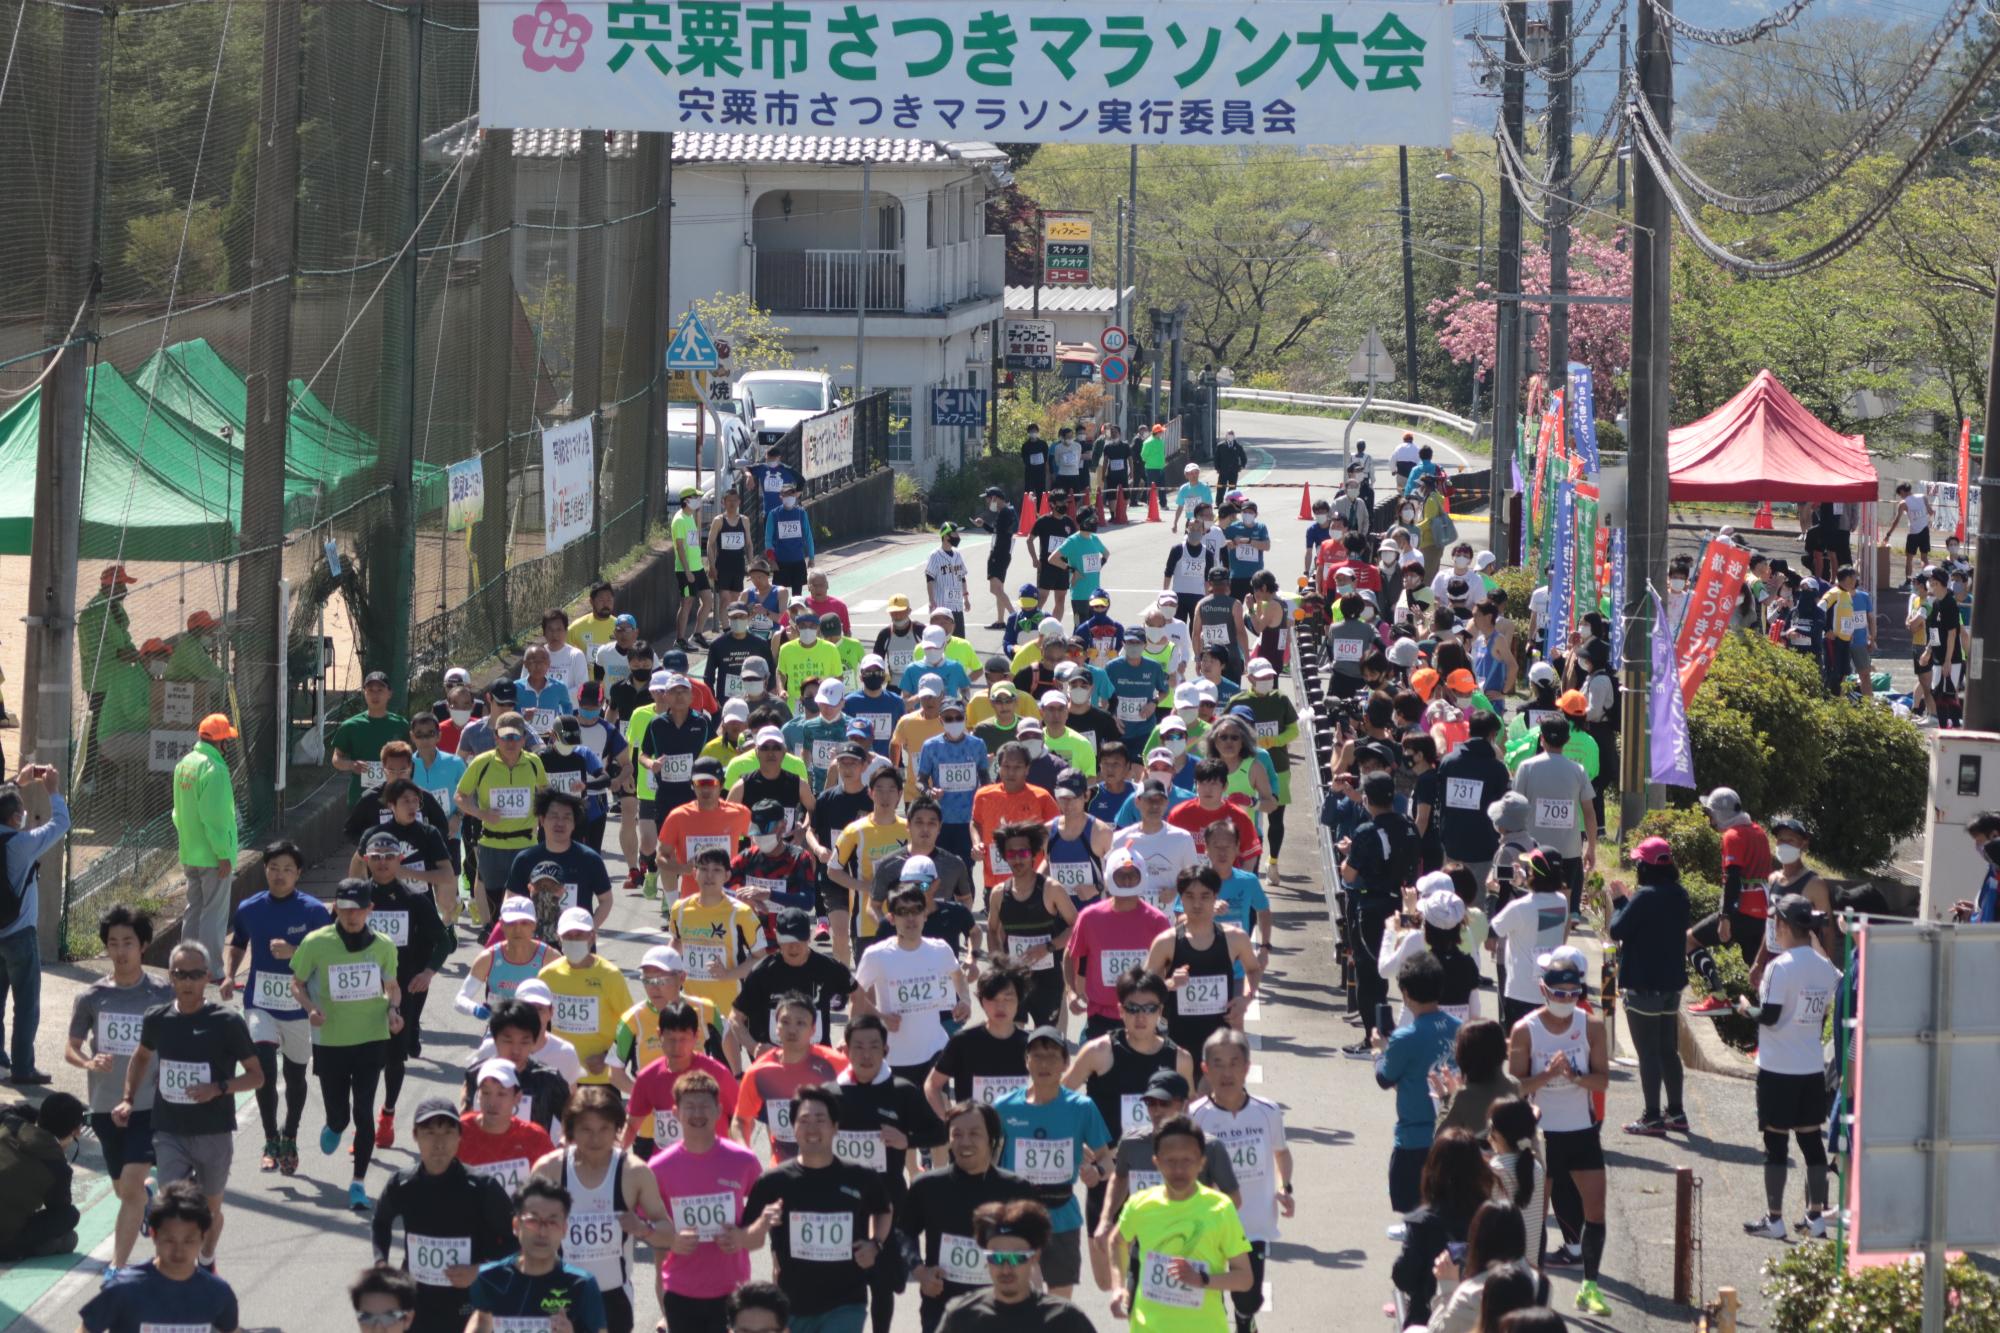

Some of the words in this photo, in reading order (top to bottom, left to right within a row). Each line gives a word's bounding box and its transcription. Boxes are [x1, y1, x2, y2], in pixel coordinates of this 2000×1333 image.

[606, 0, 1427, 91] 宍粟市さつきマラソン大会
[678, 87, 1296, 134] 宍粟市さつきマラソン実行委員会
[1050, 226, 1087, 236] ティファニー
[1052, 246, 1084, 254] スナック
[1052, 258, 1084, 267] カラオケ
[1051, 271, 1083, 280] コーヒー
[1008, 330, 1051, 342] ティファニー
[1105, 333, 1122, 347] 40
[1010, 344, 1048, 354] 営業中
[710, 381, 730, 400] 焼
[958, 392, 979, 411] IN
[936, 414, 981, 425] ティファニー
[783, 525, 797, 533] 729
[725, 536, 741, 544] 772
[1186, 561, 1202, 571] 755
[1710, 552, 1744, 581] 歓迎
[1206, 628, 1224, 639] 672
[1338, 644, 1358, 654] 406
[664, 760, 689, 773] 805
[945, 769, 971, 782] 860
[1453, 784, 1473, 798] 731
[497, 794, 525, 808] 848
[1542, 805, 1568, 819] 709
[1057, 870, 1085, 884] 636
[338, 970, 372, 989] 857
[898, 983, 934, 1003] 642
[1186, 984, 1220, 1002] 624
[557, 1003, 590, 1020] 845
[1245, 1127, 1264, 1137] live
[836, 1139, 875, 1160] 609
[1025, 1149, 1065, 1168] 876
[684, 1204, 726, 1226] 606
[570, 1222, 613, 1245] 665
[801, 1222, 844, 1245] 610
[417, 1245, 459, 1269] 603
